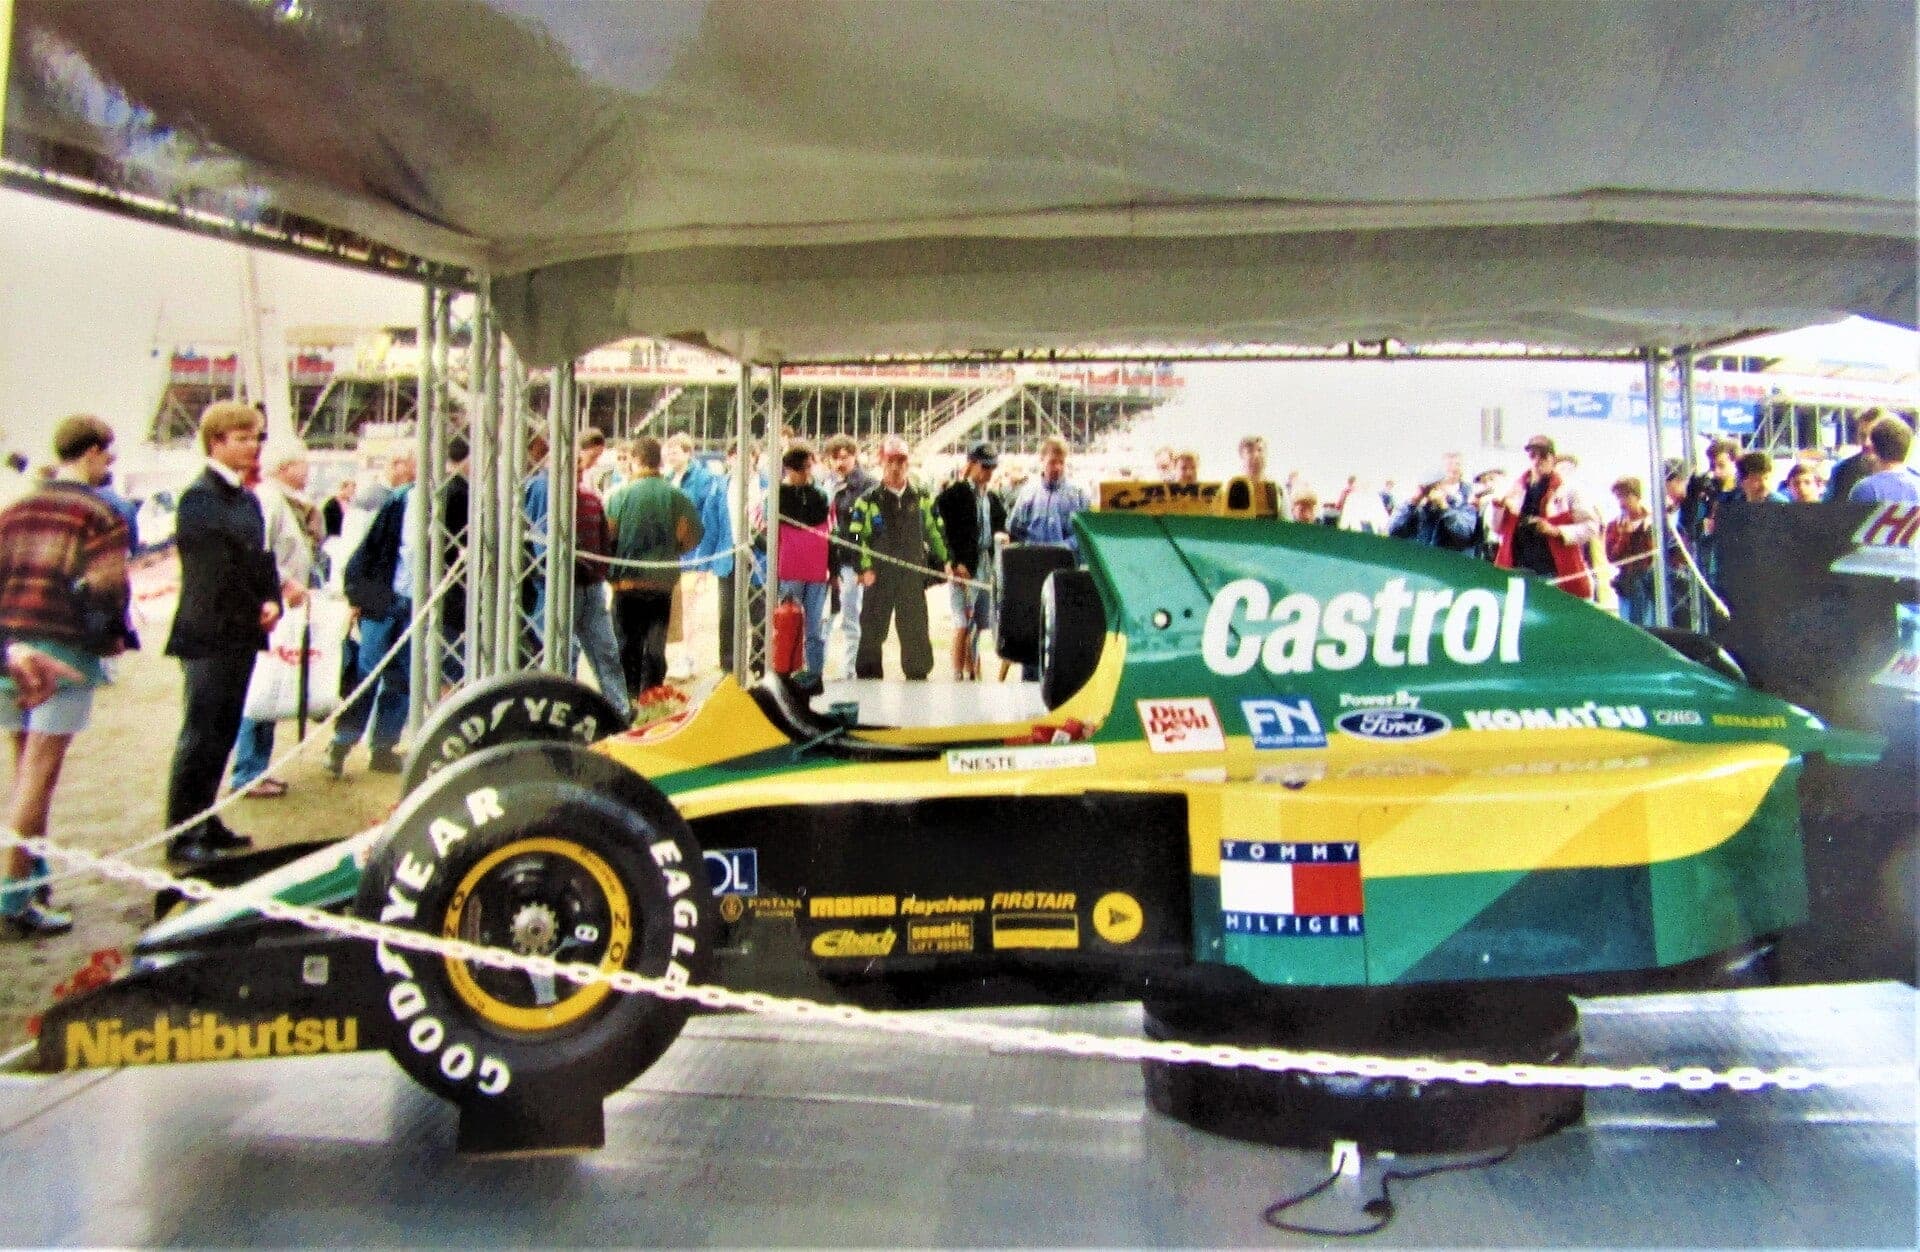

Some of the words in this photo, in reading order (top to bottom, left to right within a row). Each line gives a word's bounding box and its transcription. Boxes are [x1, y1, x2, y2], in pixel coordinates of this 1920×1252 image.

[1201, 577, 1526, 677] Castrol
[1150, 705, 1197, 720] Dirt
[1240, 699, 1322, 736] FN
[1360, 709, 1426, 735] Ford
[1463, 701, 1648, 731] KOMATSU
[1223, 842, 1356, 861] TOMMY
[992, 891, 1077, 911] FIRSTAIR
[1225, 913, 1361, 933] HILFIGER
[65, 1008, 358, 1071] Nichibutsu
